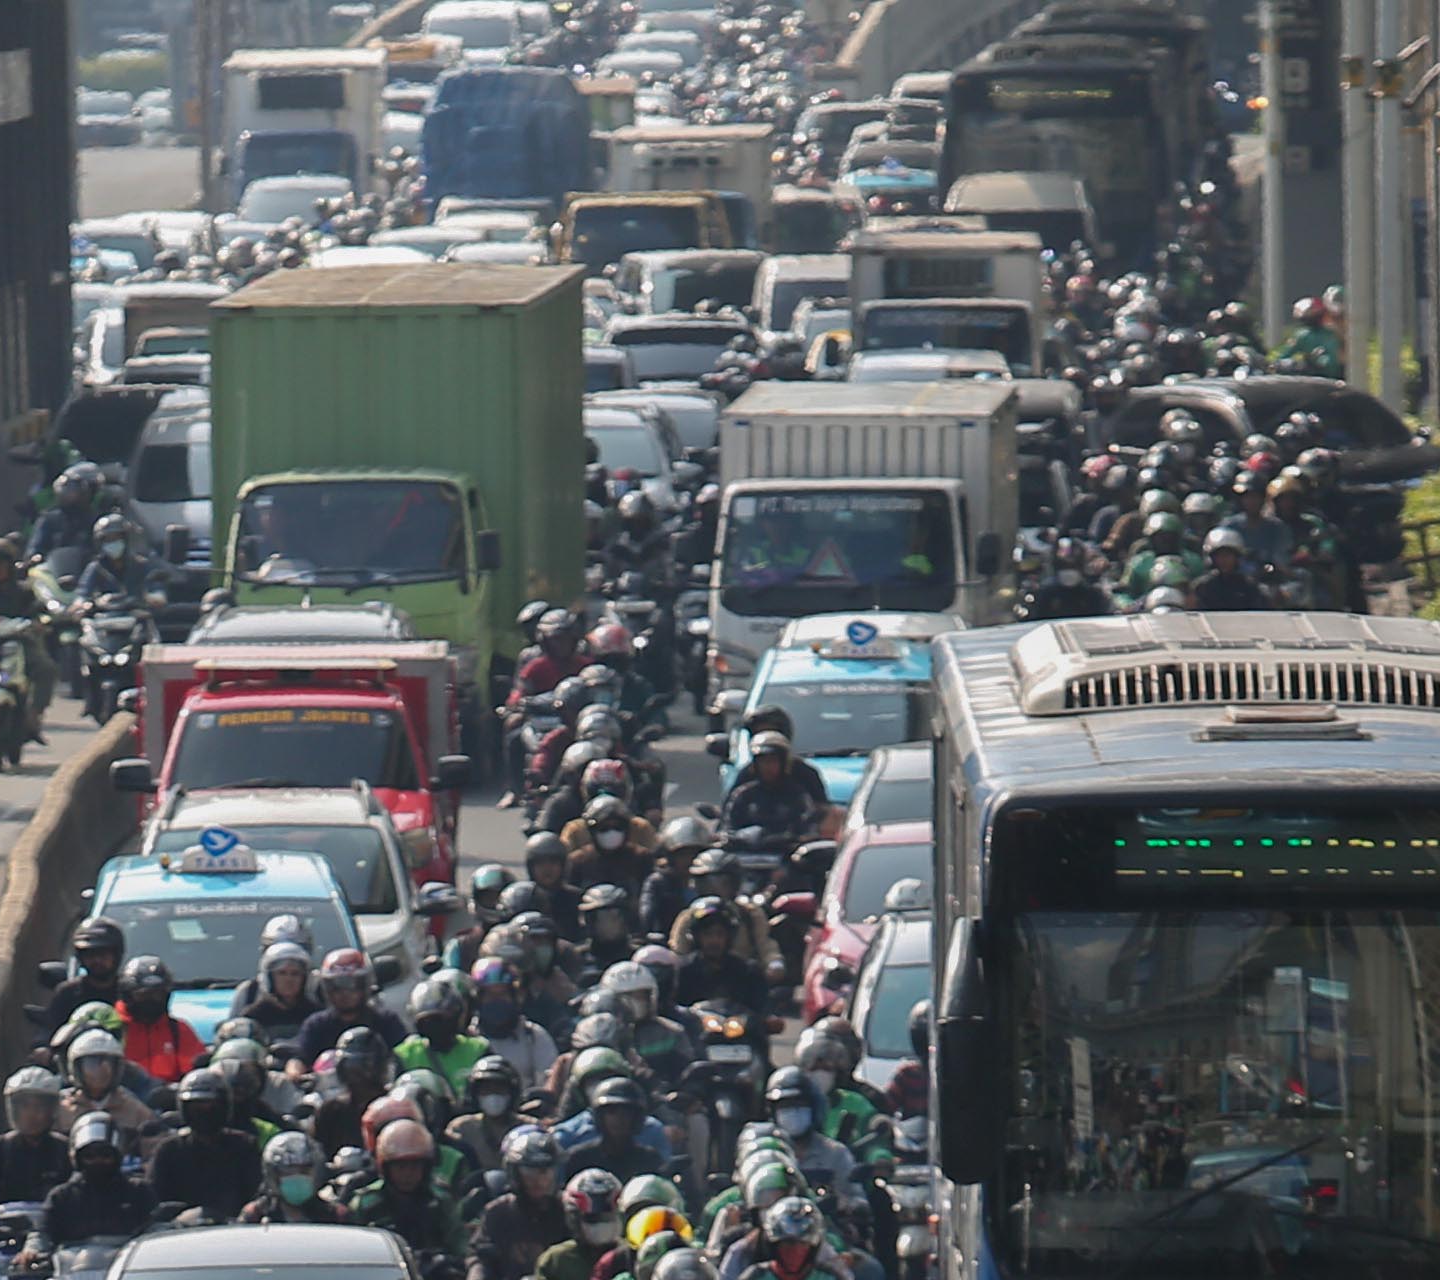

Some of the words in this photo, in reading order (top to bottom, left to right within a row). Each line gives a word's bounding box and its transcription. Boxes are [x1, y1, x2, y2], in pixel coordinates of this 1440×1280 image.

[300, 710, 370, 724] JAKARTA
[195, 857, 248, 868] TAKSI
[174, 902, 258, 915] Bluebird
